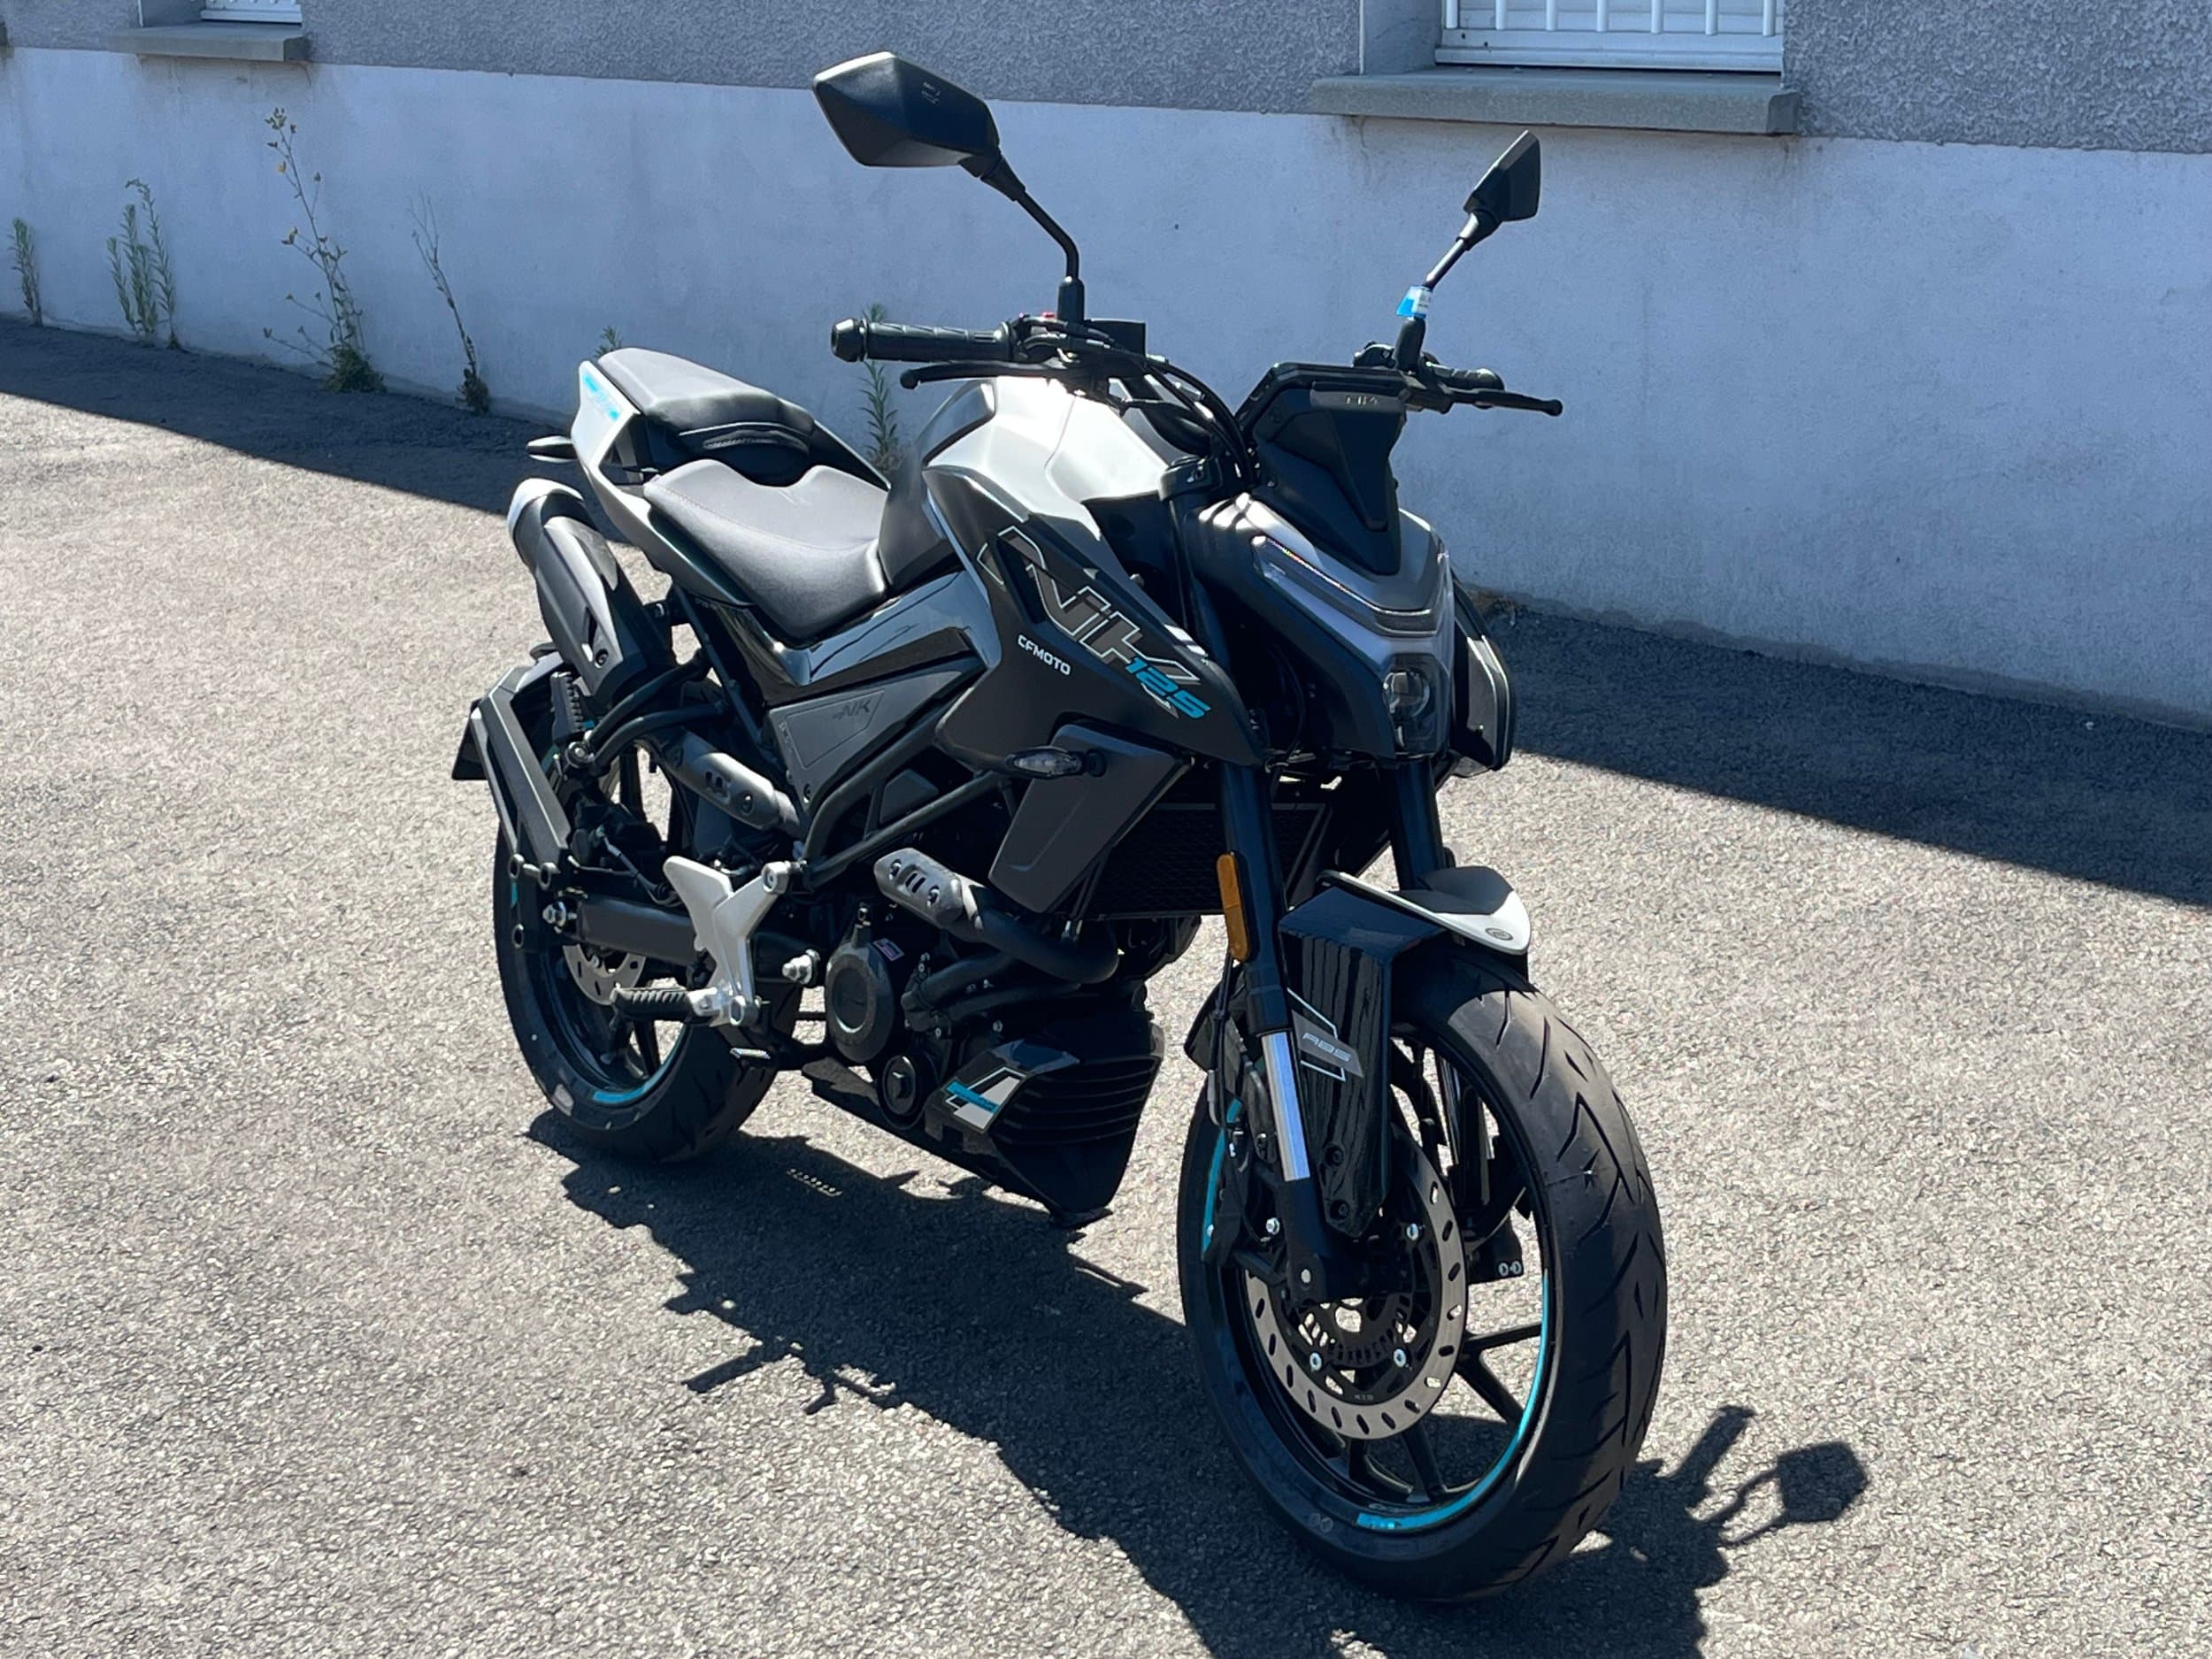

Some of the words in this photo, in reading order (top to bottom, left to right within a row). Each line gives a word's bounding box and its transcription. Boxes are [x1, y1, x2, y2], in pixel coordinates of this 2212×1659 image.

[1018, 634, 1071, 675] CFMOTO
[1125, 657, 1211, 718] 125
[1302, 1033, 1352, 1062] ABS
